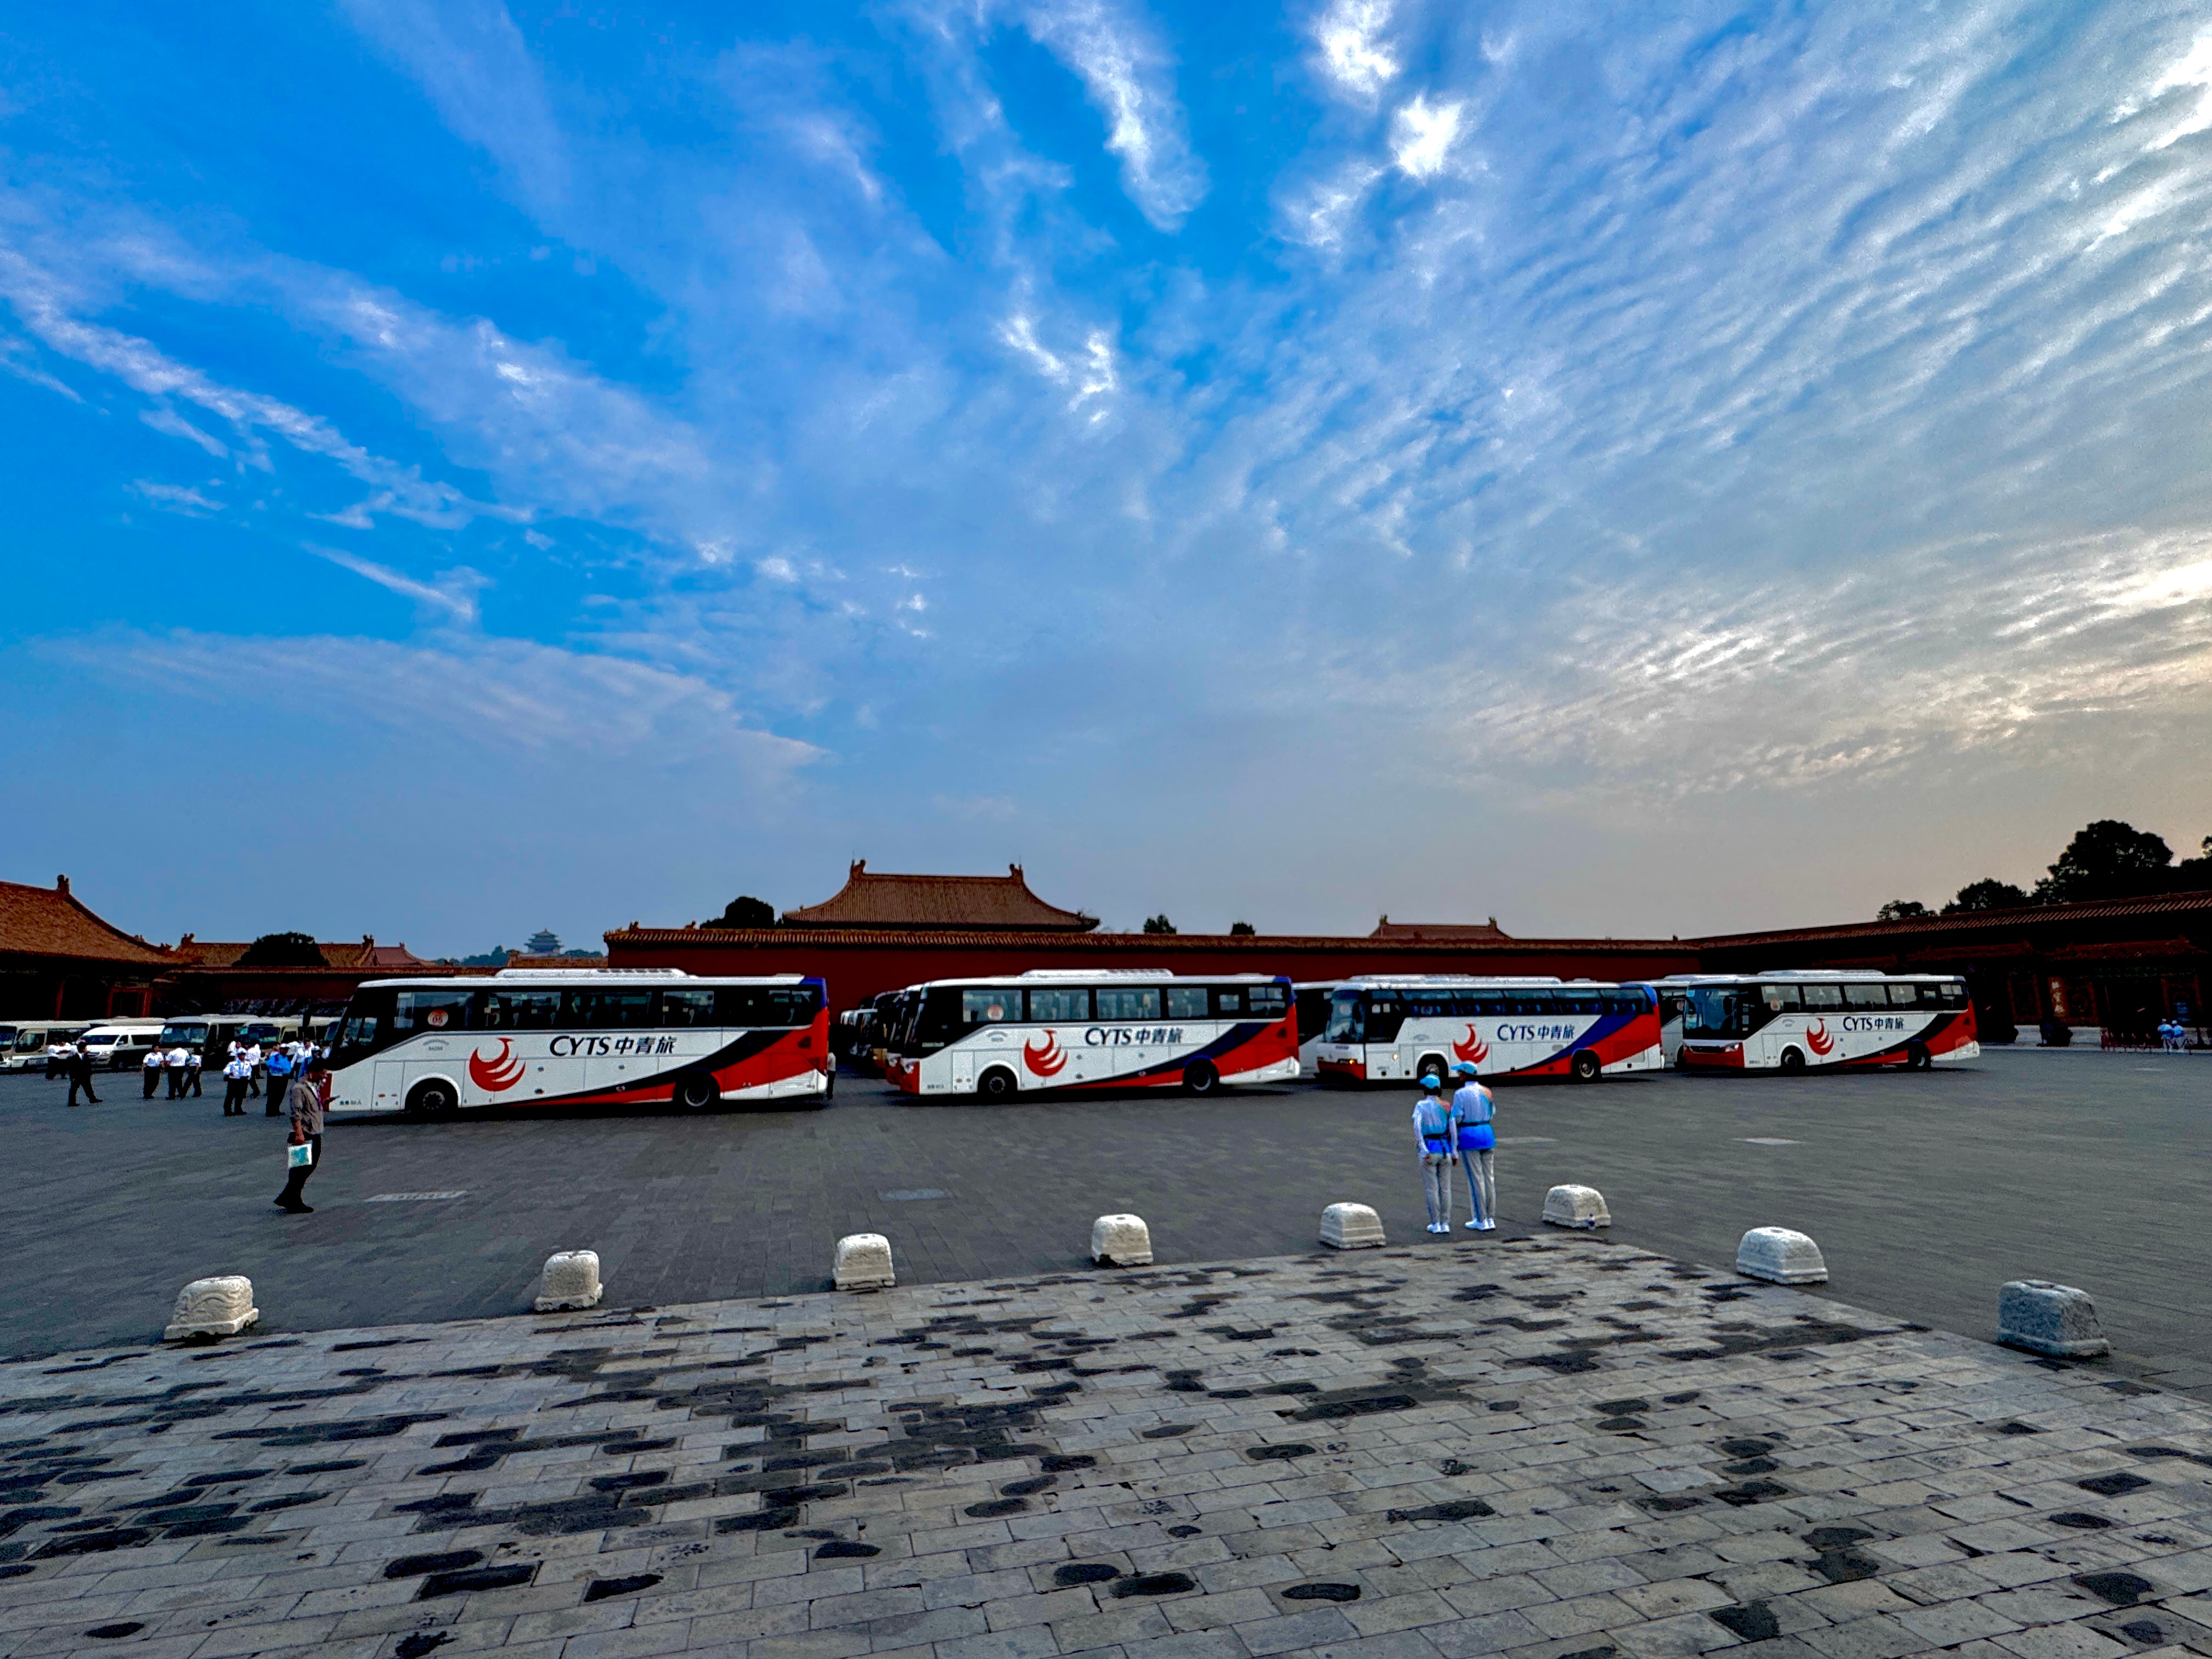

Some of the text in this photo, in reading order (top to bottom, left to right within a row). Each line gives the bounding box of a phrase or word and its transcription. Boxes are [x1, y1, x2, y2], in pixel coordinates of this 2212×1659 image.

[1843, 1016, 1872, 1031] CYTS
[1085, 1027, 1132, 1045] CYTS
[1497, 1024, 1534, 1041] CYTS
[550, 1036, 677, 1056] CYTS 中青旅
